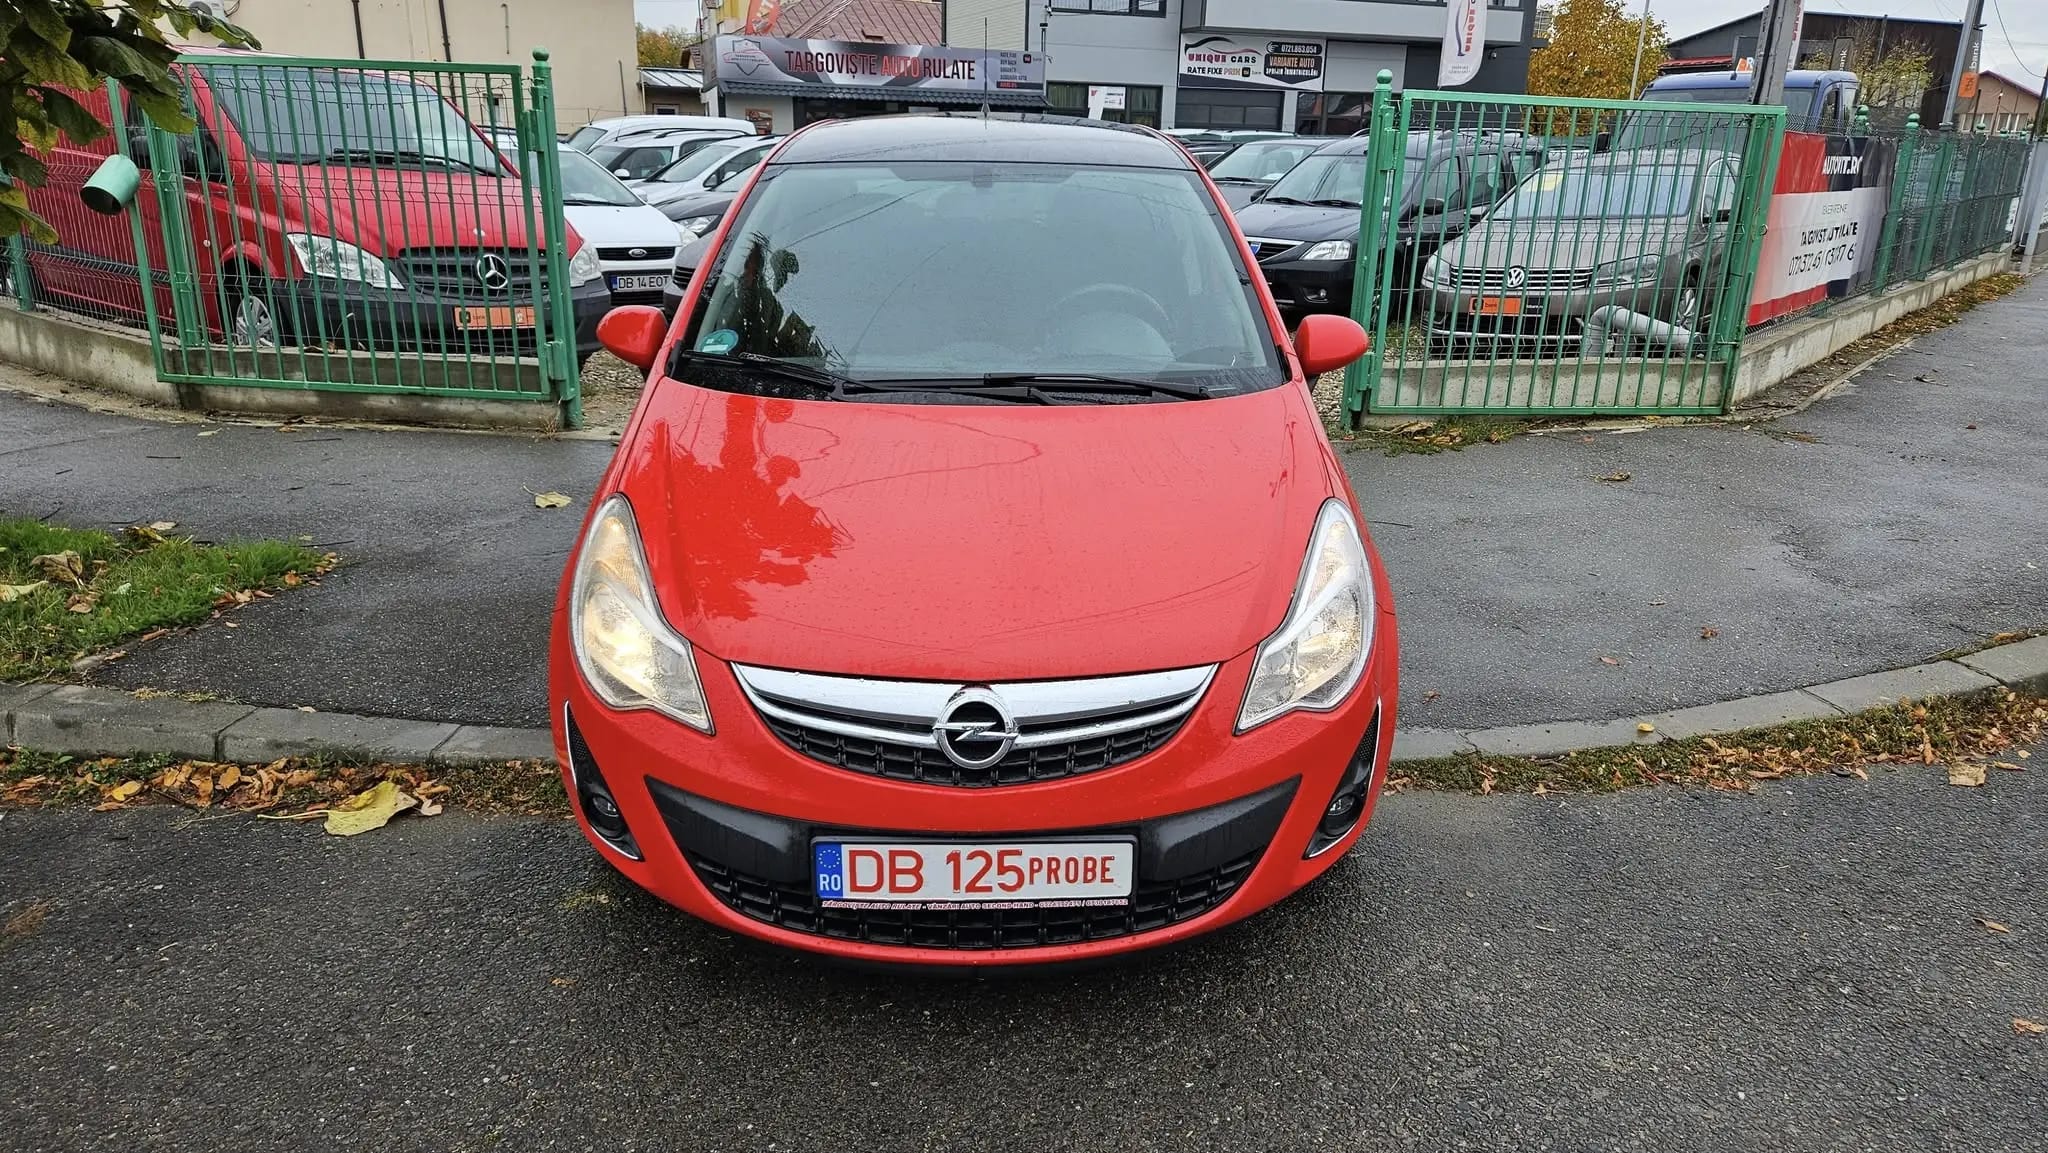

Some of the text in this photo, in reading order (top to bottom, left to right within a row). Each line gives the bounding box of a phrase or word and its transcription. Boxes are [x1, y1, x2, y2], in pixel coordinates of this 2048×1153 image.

[1188, 53, 1257, 64] UNIQUE CARS
[1270, 56, 1315, 68] VARIANTE AUTO
[1840, 48, 1848, 70] ank
[1969, 42, 1979, 69] bank
[881, 54, 920, 78] AUTO
[924, 57, 976, 80] RULATE
[1187, 66, 1206, 75] RATE
[1207, 67, 1223, 75] FIXE
[618, 277, 634, 289] DB
[638, 276, 647, 288] 14
[819, 848, 1116, 894] RO DB 125 PROBE
